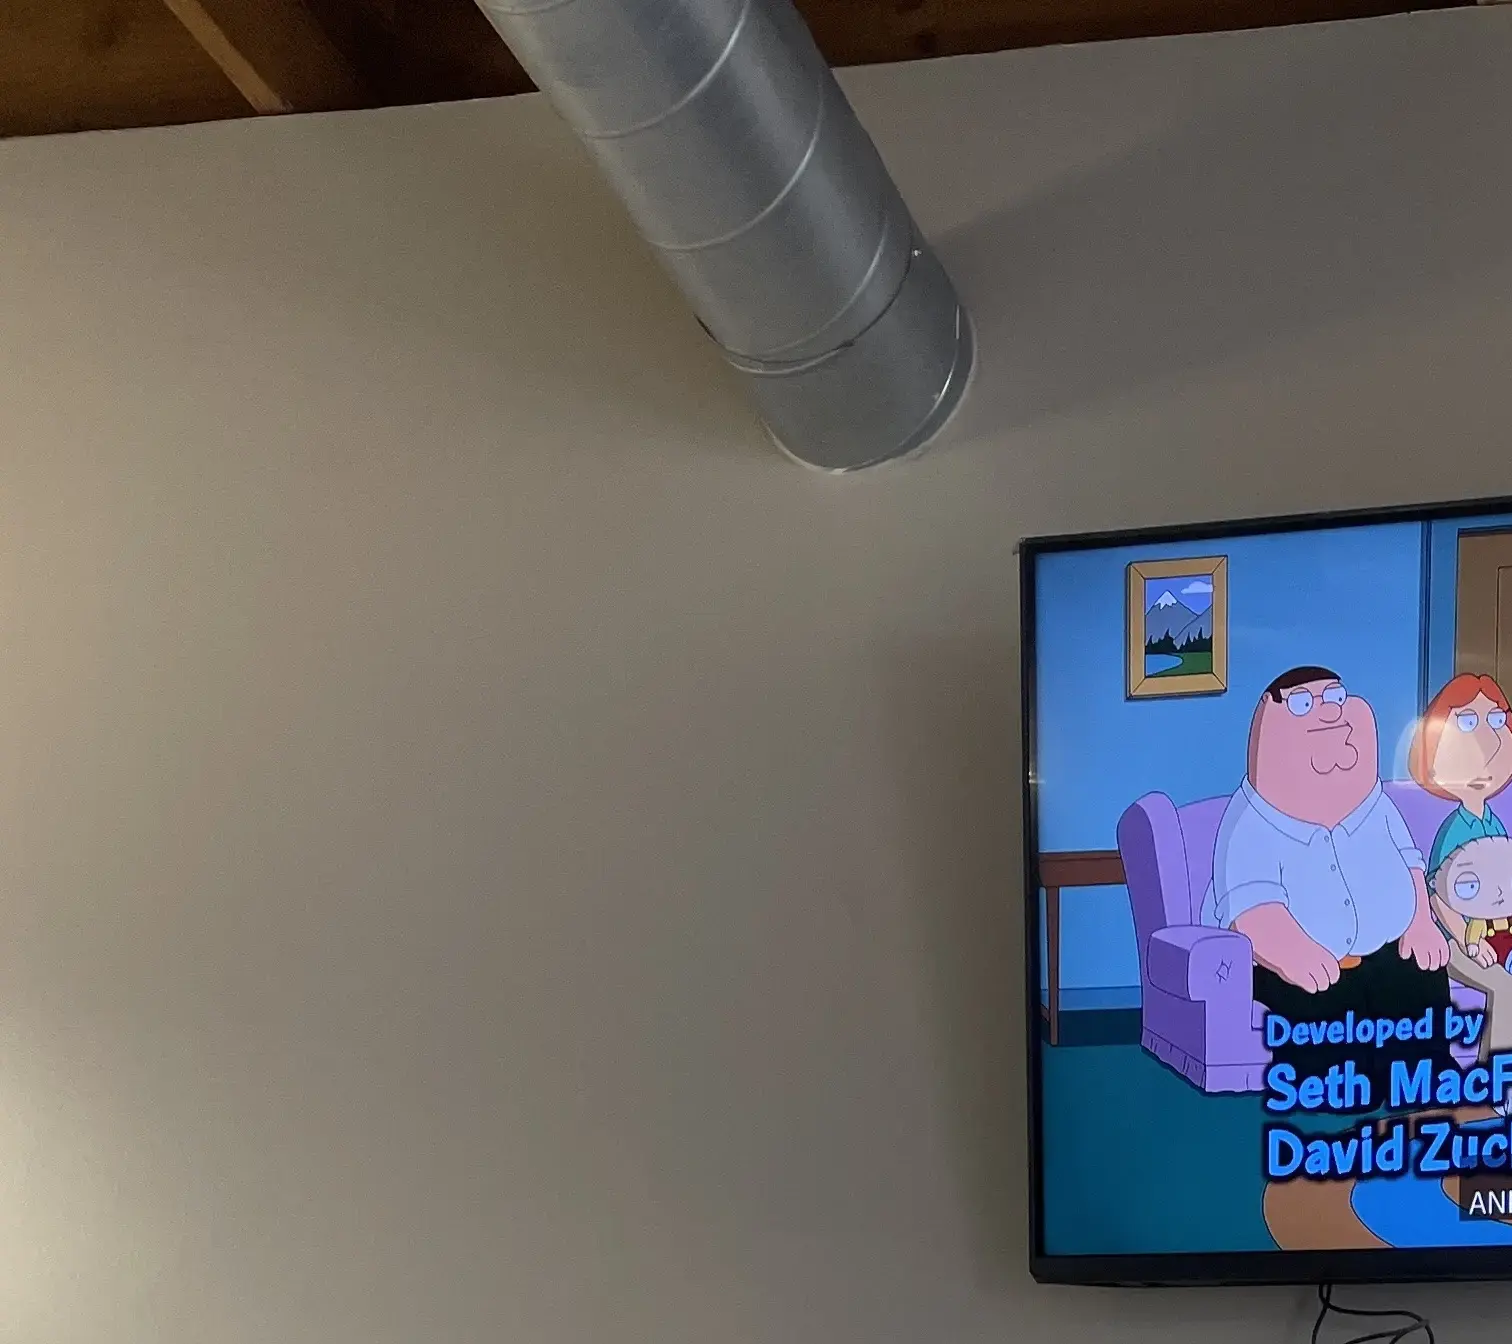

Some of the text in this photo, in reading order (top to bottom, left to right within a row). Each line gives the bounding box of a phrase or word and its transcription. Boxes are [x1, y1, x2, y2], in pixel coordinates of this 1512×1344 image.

[1267, 1008, 1483, 1048] Developed by
[1266, 1061, 1371, 1110] Seth
[1267, 1124, 1403, 1177] David
